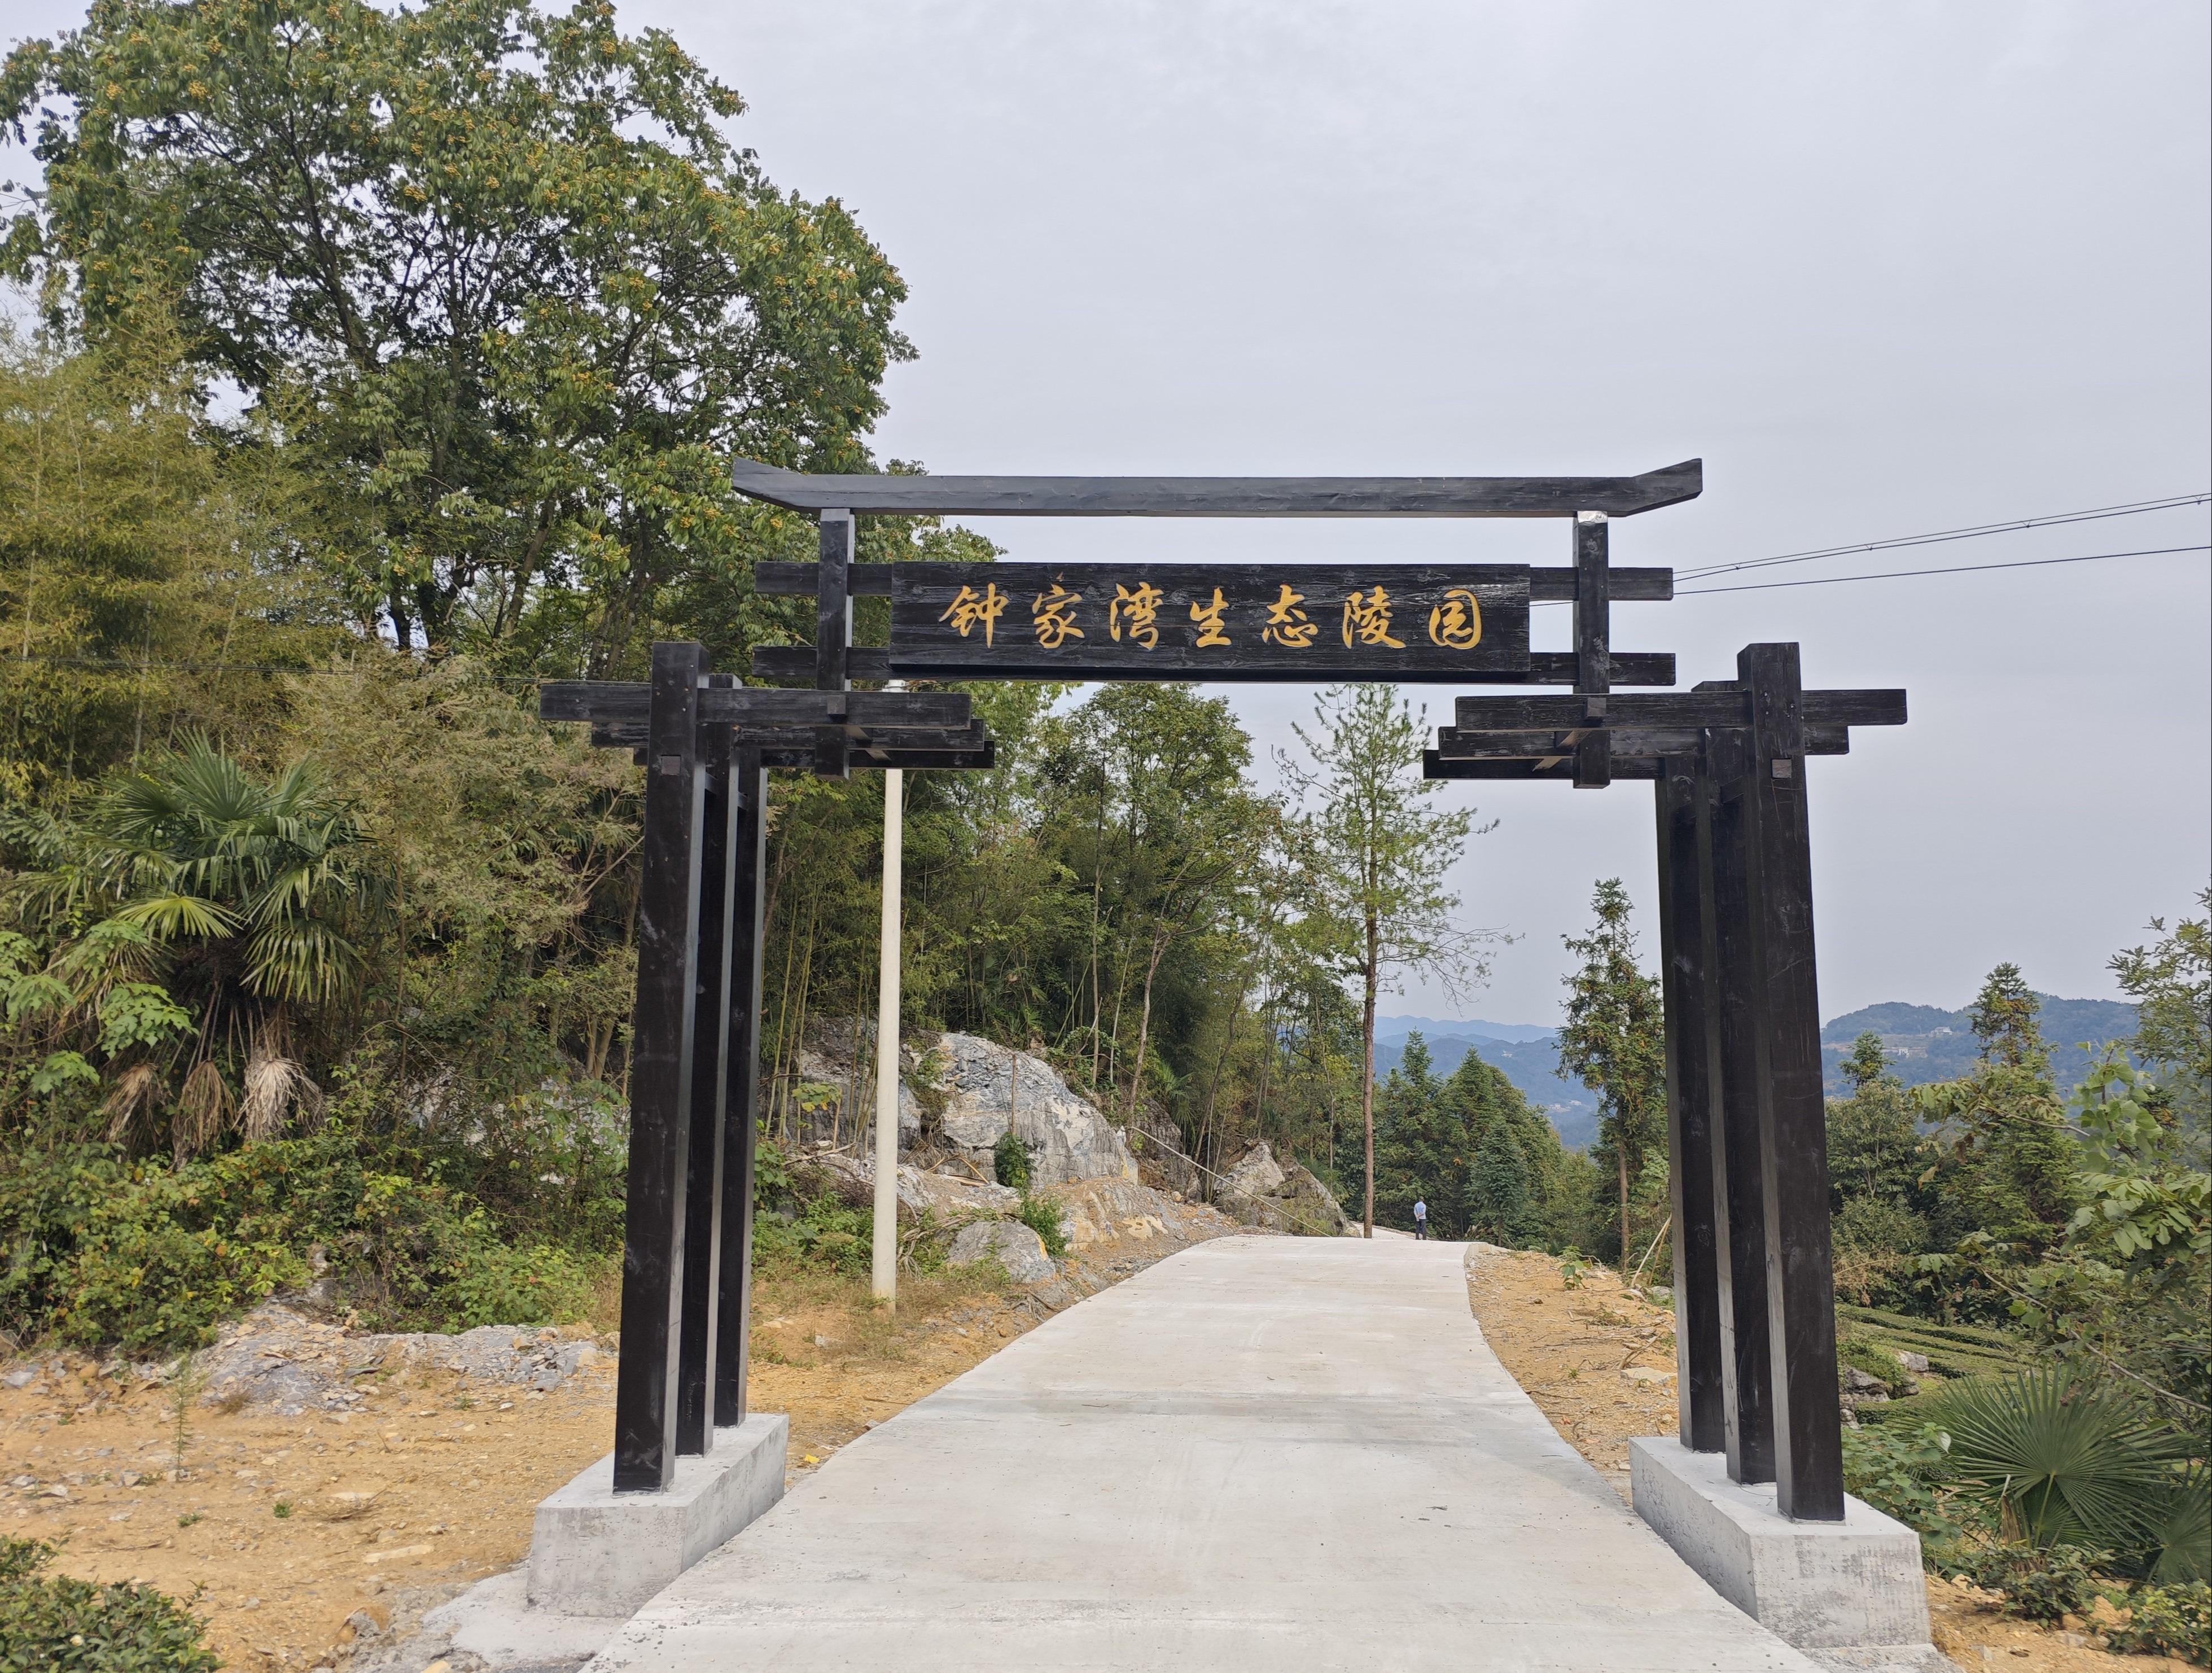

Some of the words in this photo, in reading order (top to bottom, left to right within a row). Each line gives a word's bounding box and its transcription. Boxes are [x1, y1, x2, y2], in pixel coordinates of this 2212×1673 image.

[939, 582, 1482, 650] 钟家湾生态陵园
